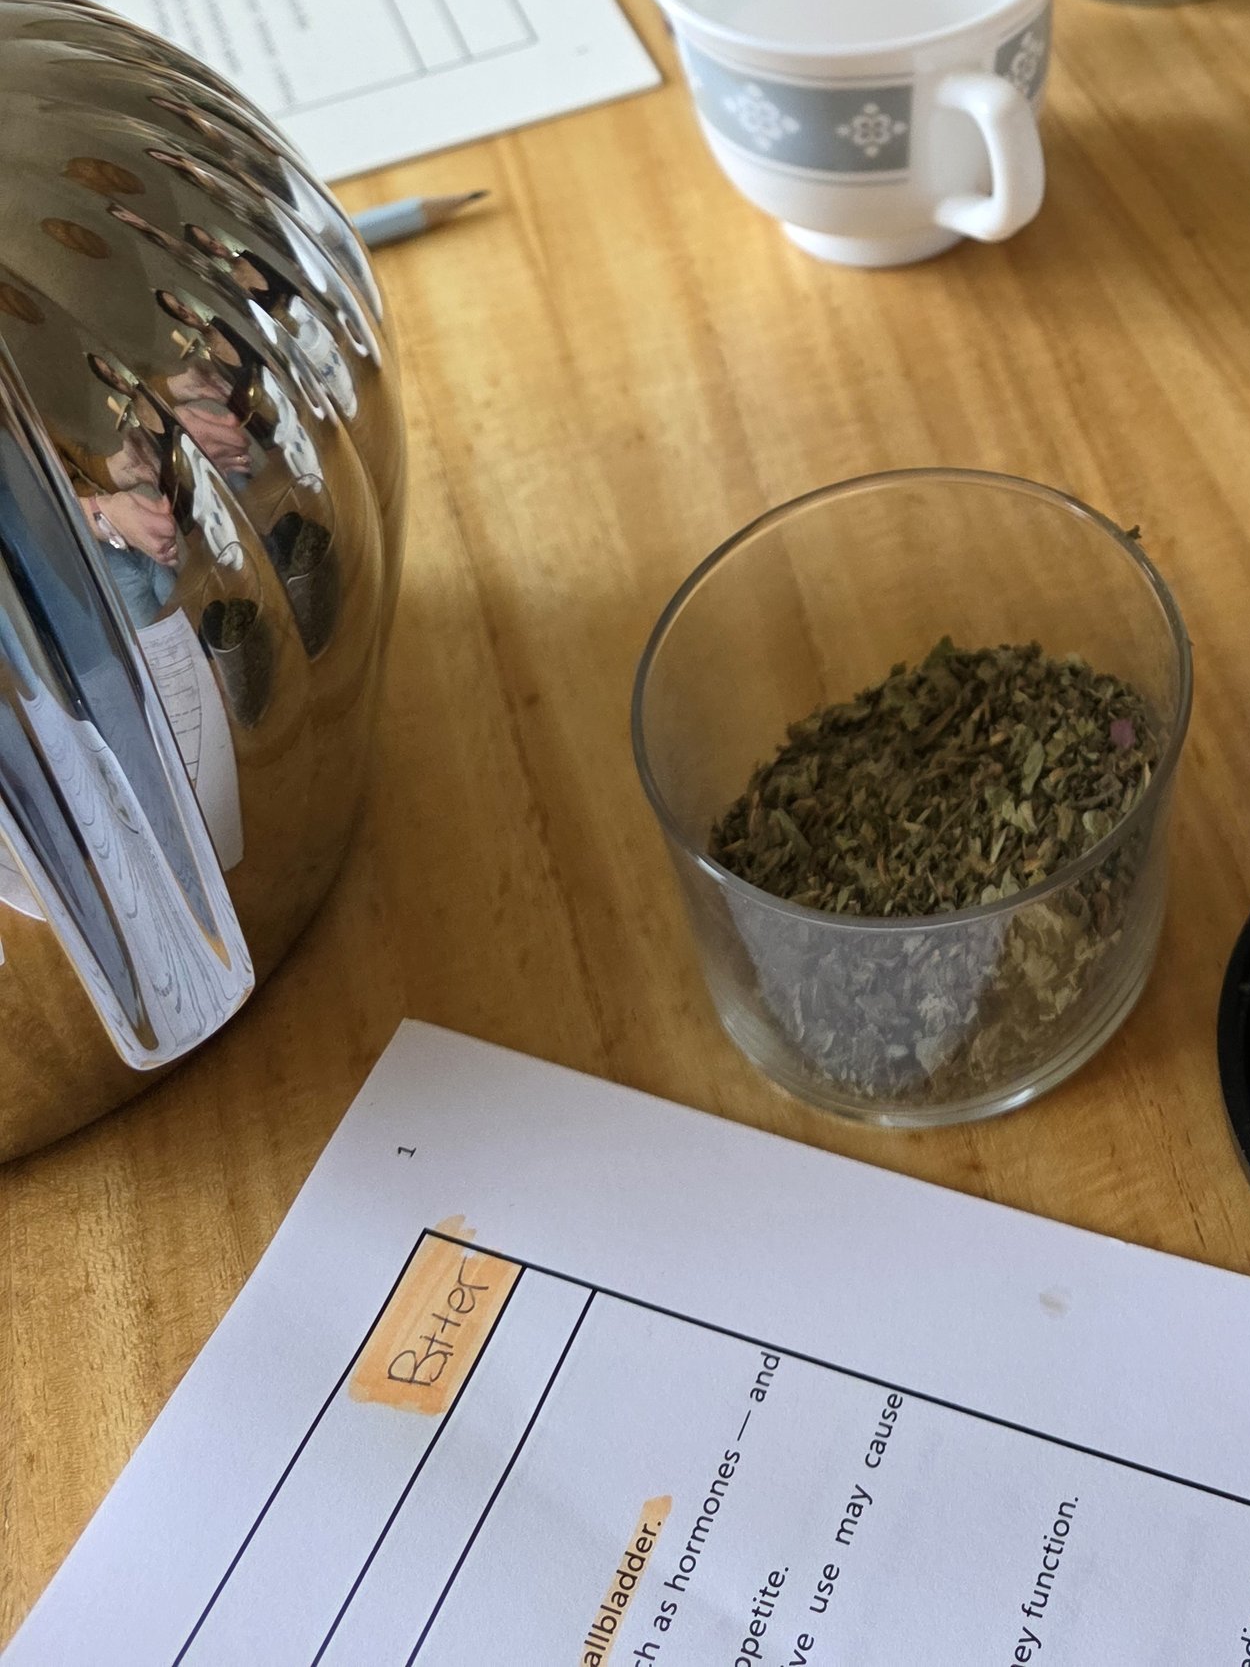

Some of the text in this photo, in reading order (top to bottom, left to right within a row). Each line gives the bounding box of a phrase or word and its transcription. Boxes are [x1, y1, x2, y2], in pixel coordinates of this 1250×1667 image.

[397, 1146, 417, 1158] 1
[749, 1352, 781, 1403] and
[663, 1449, 741, 1593] hormones
[779, 1393, 904, 1667] ve use may cause
[653, 1599, 678, 1633] as
[1010, 1496, 1079, 1667] ey function.
